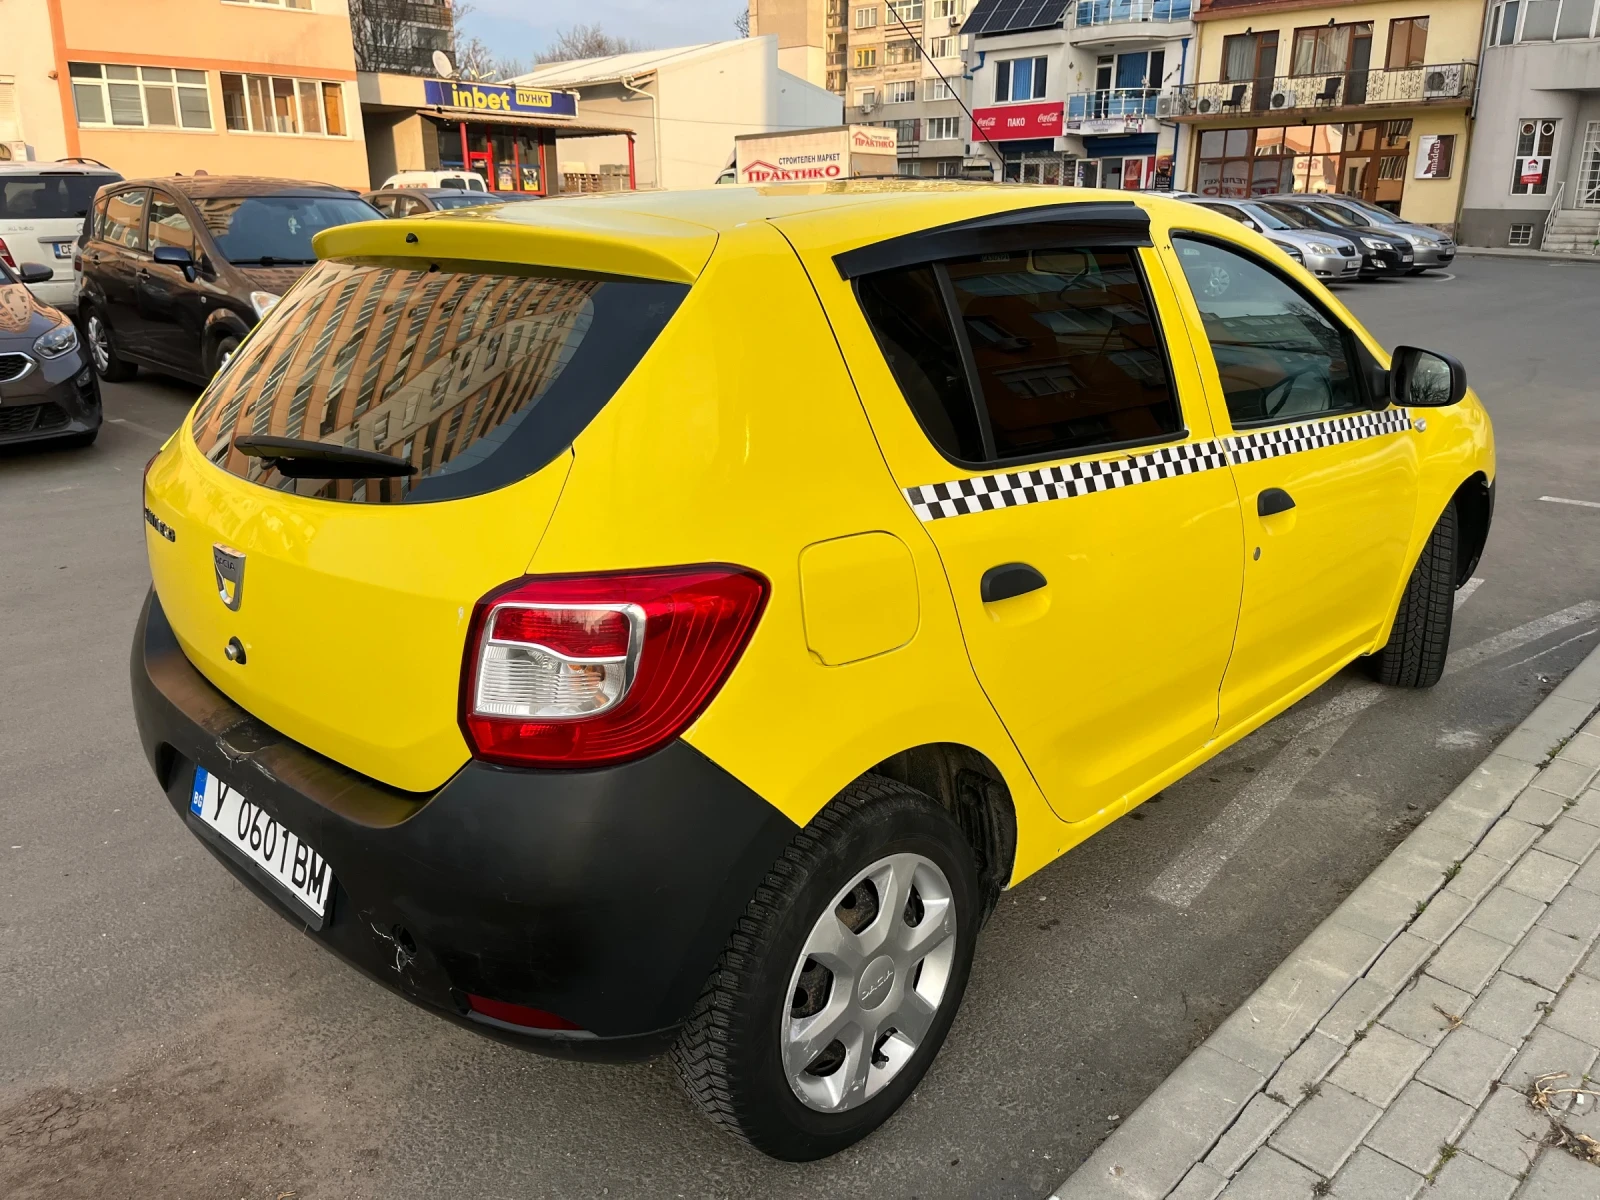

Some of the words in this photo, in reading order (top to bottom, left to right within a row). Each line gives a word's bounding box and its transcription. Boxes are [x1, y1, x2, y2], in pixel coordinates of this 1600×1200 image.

[452, 83, 511, 111] inbet
[518, 92, 549, 104] ПУНКТ
[1007, 117, 1026, 127] ПАКО
[854, 137, 895, 149] ПРАКТИКО
[778, 154, 816, 165] СТРОИТЕЛЕН
[816, 152, 840, 163] МАРКЕТ
[1430, 139, 1441, 175] amadeus
[747, 164, 841, 183] ПРАКТИКО
[193, 791, 203, 808] BG
[213, 779, 230, 821] Y
